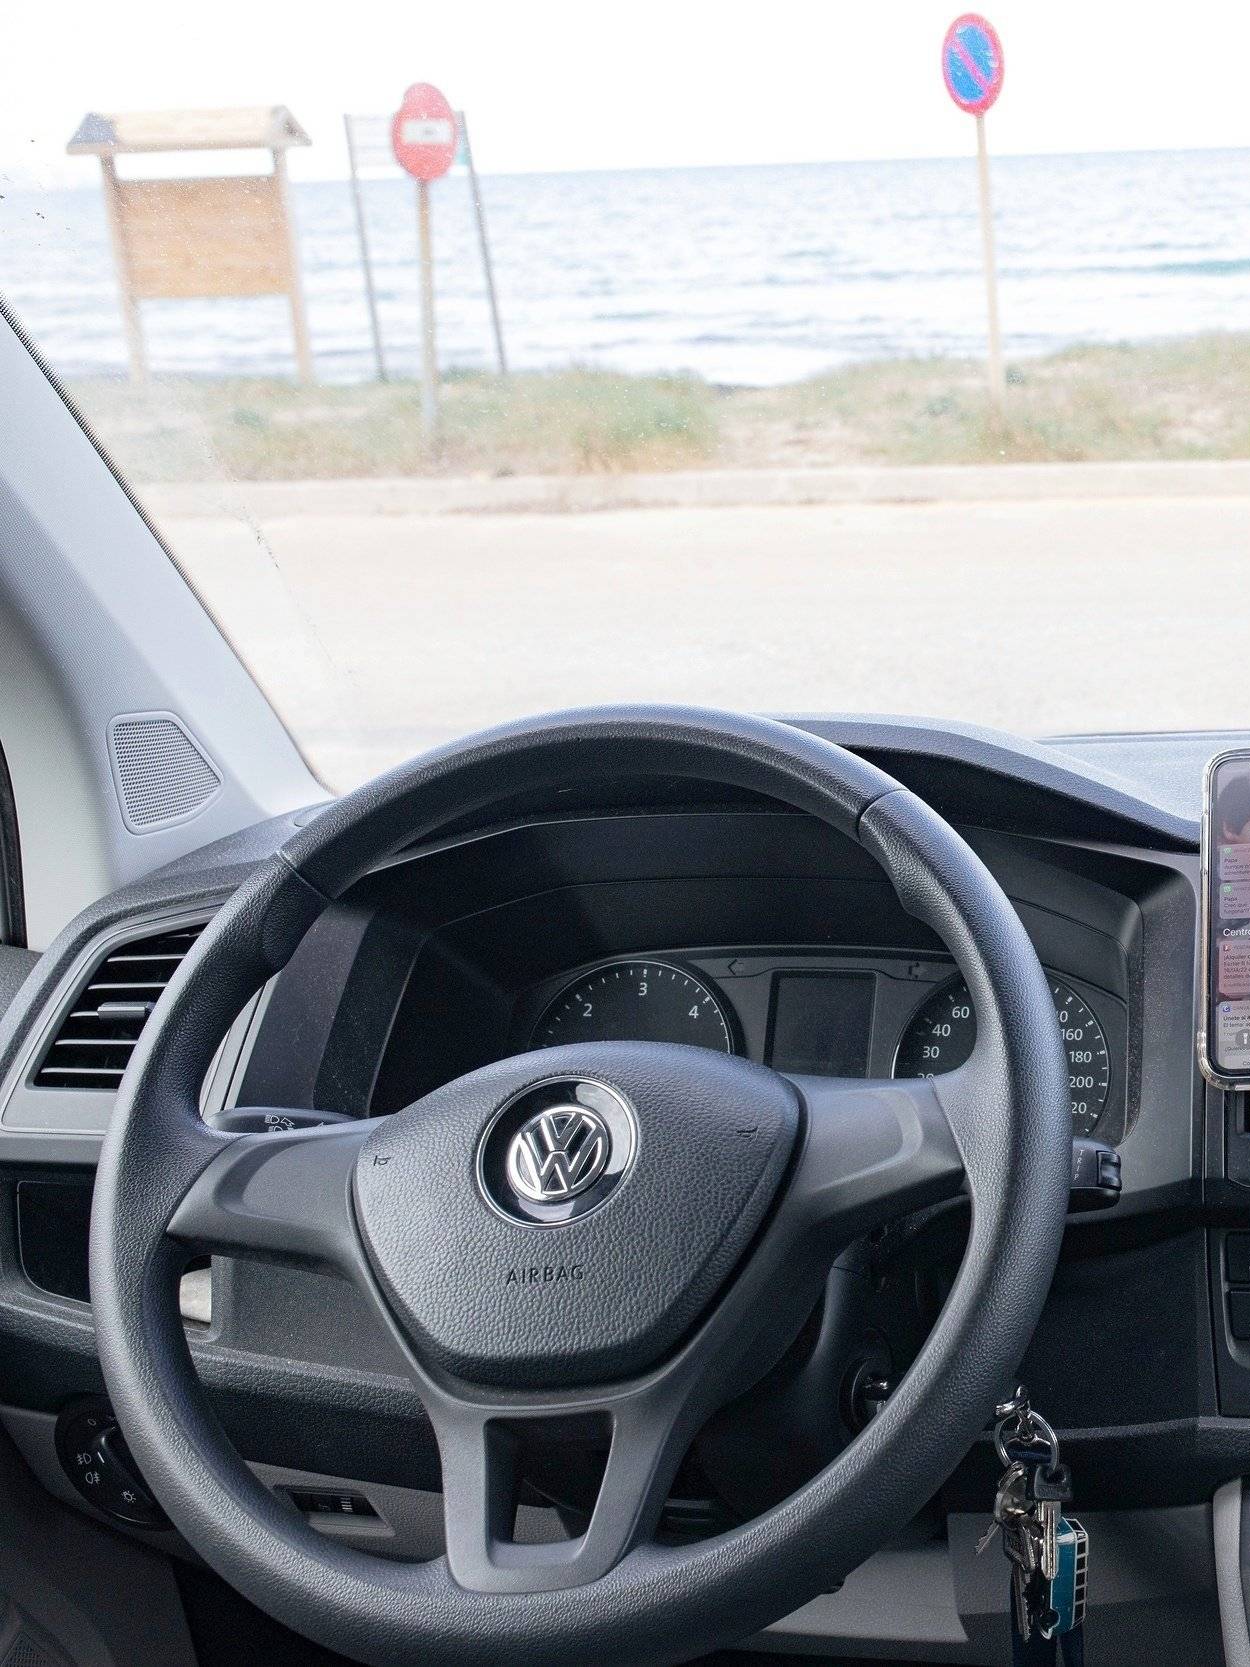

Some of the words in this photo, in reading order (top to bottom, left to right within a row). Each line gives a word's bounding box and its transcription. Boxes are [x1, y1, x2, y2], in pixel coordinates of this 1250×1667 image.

[638, 983, 648, 996] 3
[583, 1003, 593, 1017] 2
[688, 1005, 699, 1019] 4
[952, 1006, 970, 1018] 60
[932, 1024, 951, 1036] 40
[1061, 1028, 1083, 1041] 160
[922, 1046, 940, 1058] 30
[1070, 1051, 1092, 1063] 180
[1069, 1076, 1094, 1088] 200
[1072, 1102, 1087, 1114] 20
[1073, 1150, 1084, 1181] TRIP
[506, 1265, 584, 1286] AIRBAG
